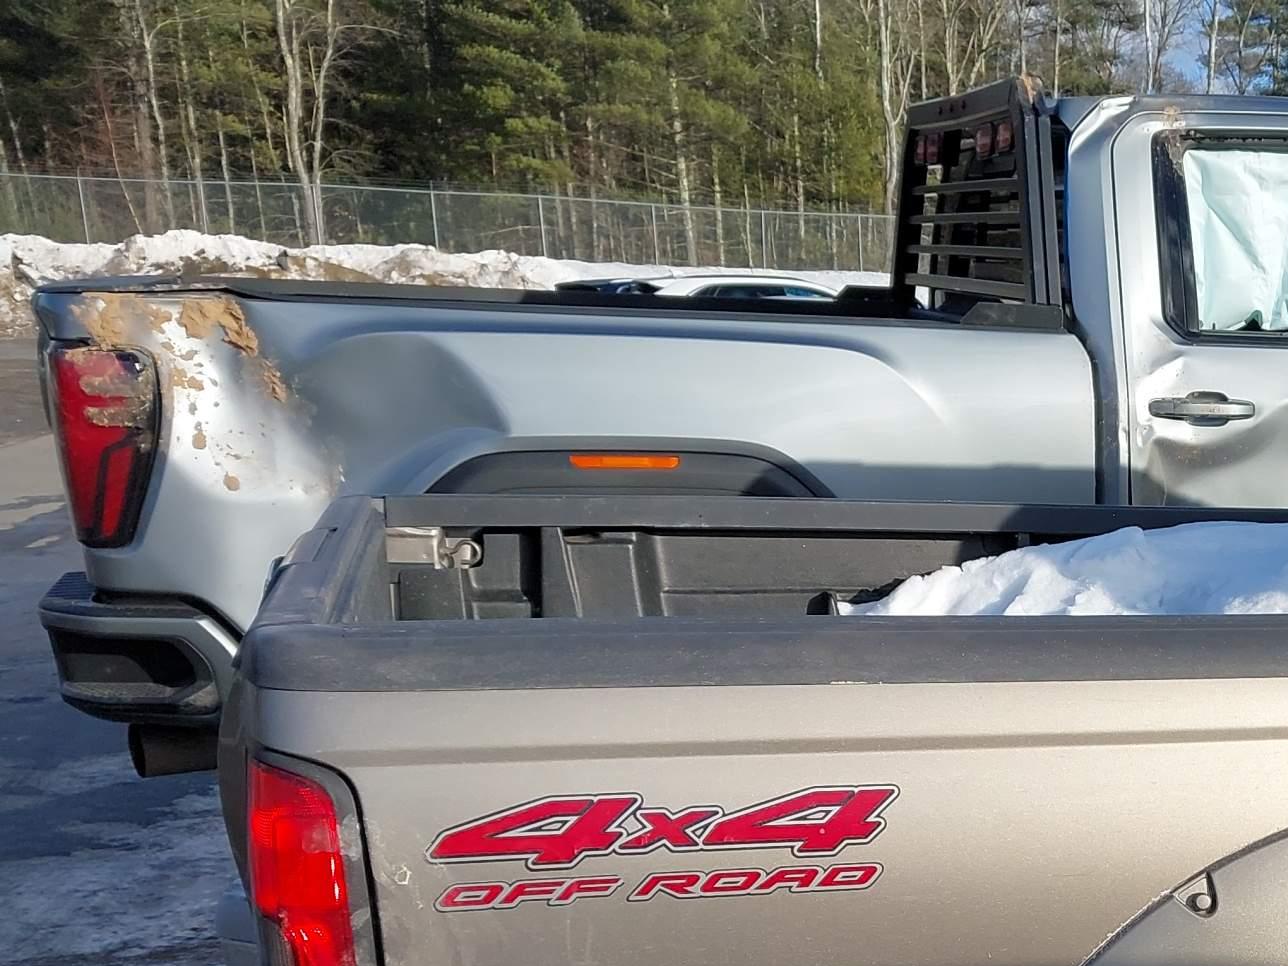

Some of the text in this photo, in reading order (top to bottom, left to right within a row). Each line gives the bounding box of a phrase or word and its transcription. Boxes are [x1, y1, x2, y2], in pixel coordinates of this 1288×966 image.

[427, 785, 899, 869] 4x4
[435, 863, 883, 912] OFF ROAD
